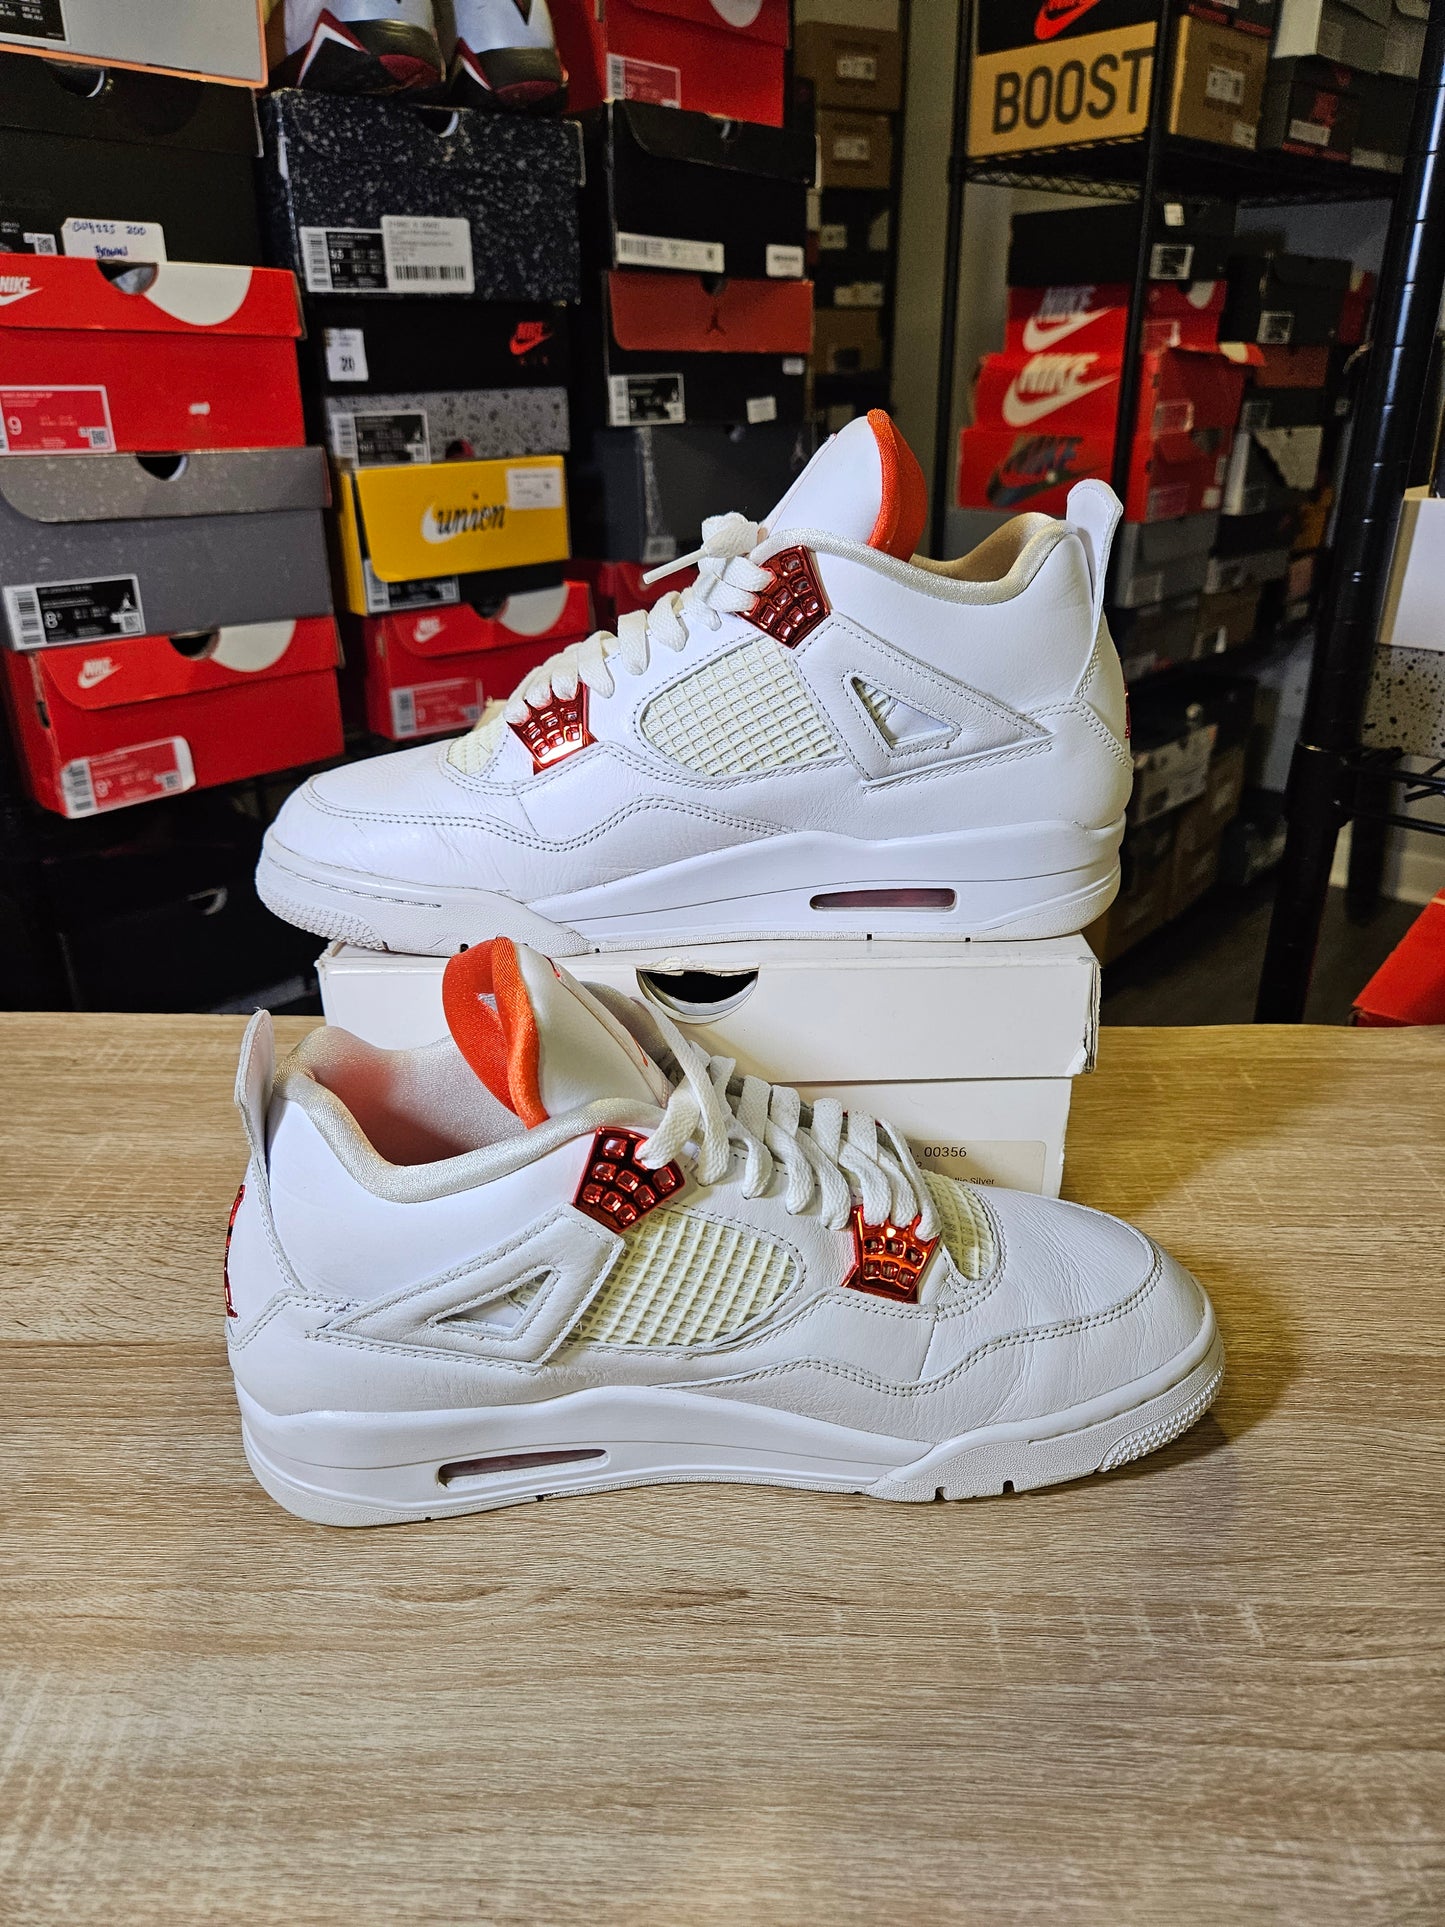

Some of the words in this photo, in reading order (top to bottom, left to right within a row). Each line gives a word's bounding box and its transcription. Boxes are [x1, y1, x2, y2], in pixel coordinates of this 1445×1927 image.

[993, 46, 1155, 135] BOOST
[0, 276, 31, 293] NIKE
[1040, 285, 1097, 320] NIKE
[1017, 353, 1099, 394] NIKE
[8, 415, 22, 436] 9
[1002, 434, 1084, 476] NIKE
[436, 492, 506, 536] union
[924, 1146, 967, 1158] 00356
[970, 1177, 995, 1185] Silver
